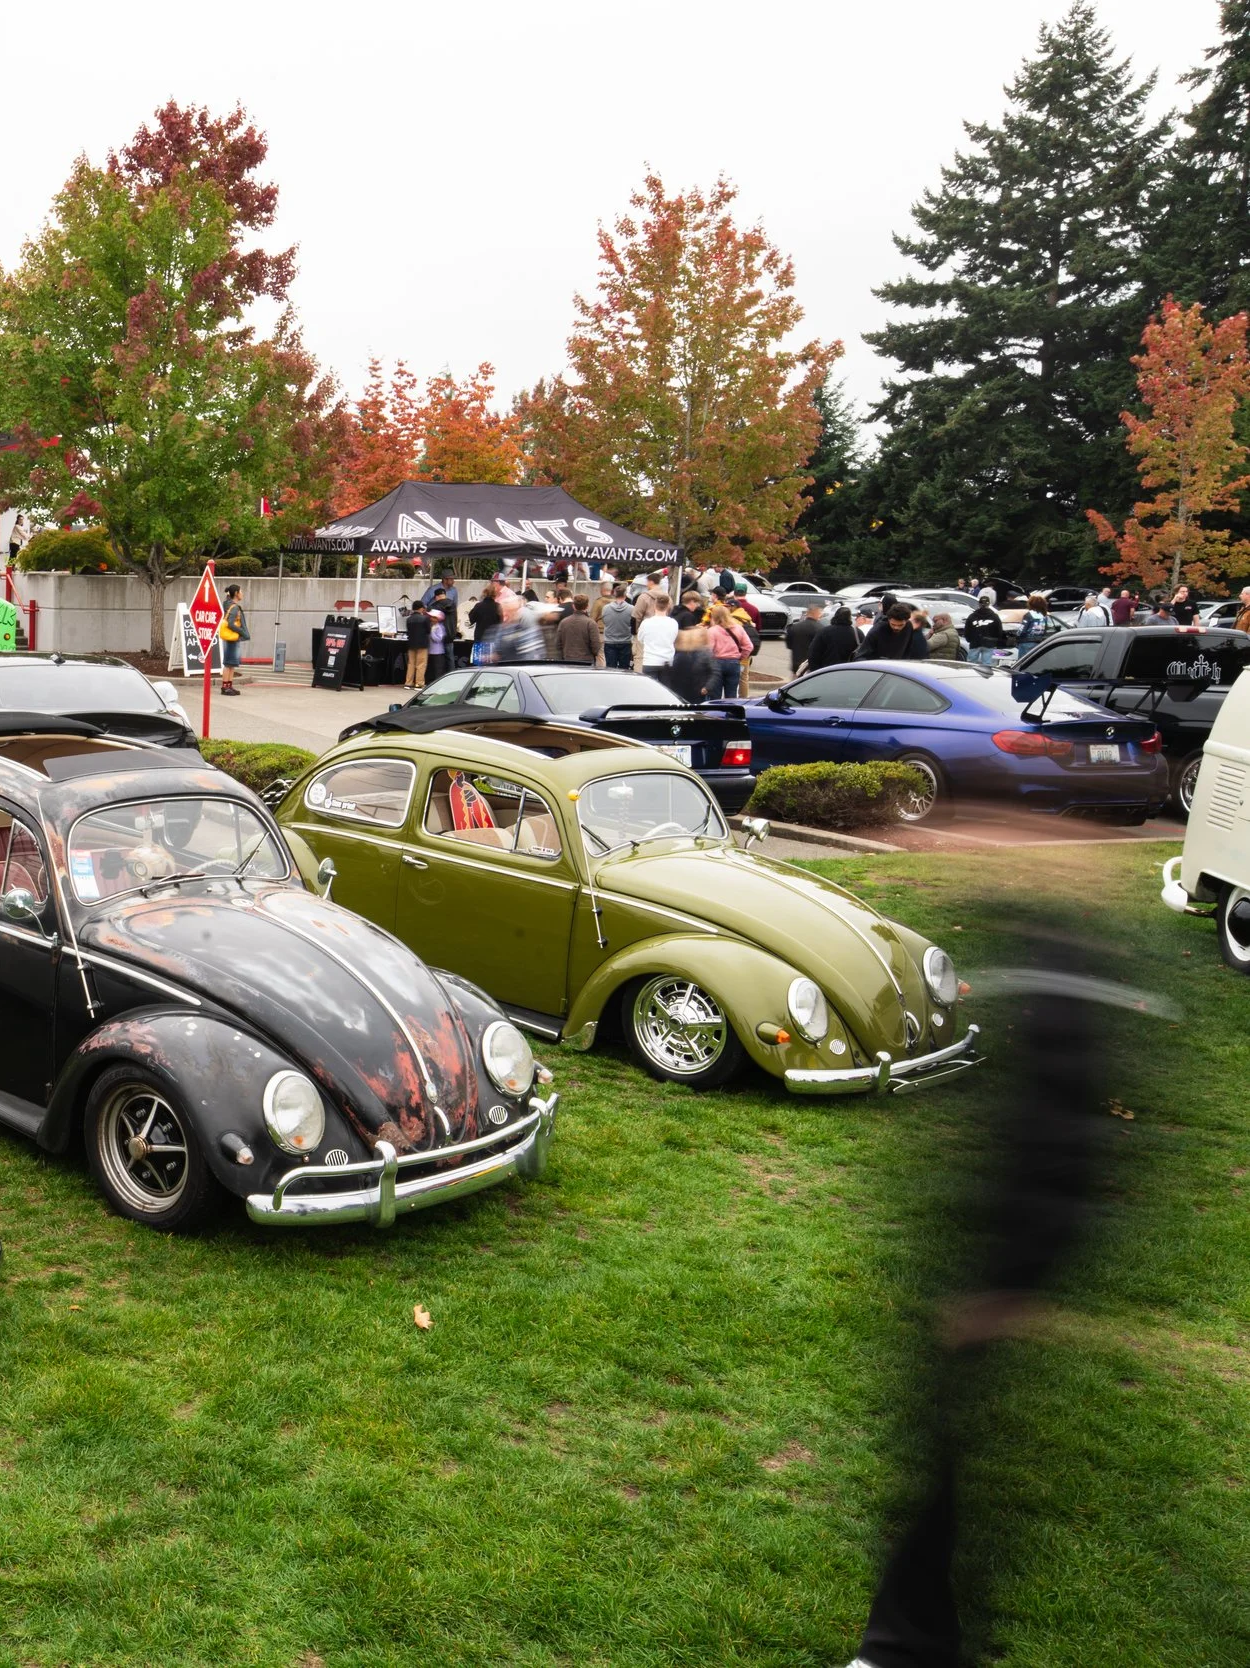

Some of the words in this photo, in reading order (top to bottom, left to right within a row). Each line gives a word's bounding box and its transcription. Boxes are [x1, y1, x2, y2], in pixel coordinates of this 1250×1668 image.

[398, 510, 614, 545] AVANTS
[371, 539, 428, 553] AVANTS
[545, 543, 678, 562] WWW.AVANTS.COM
[195, 610, 205, 623] CAR
[205, 611, 217, 624] CARE
[198, 627, 213, 640] STORE
